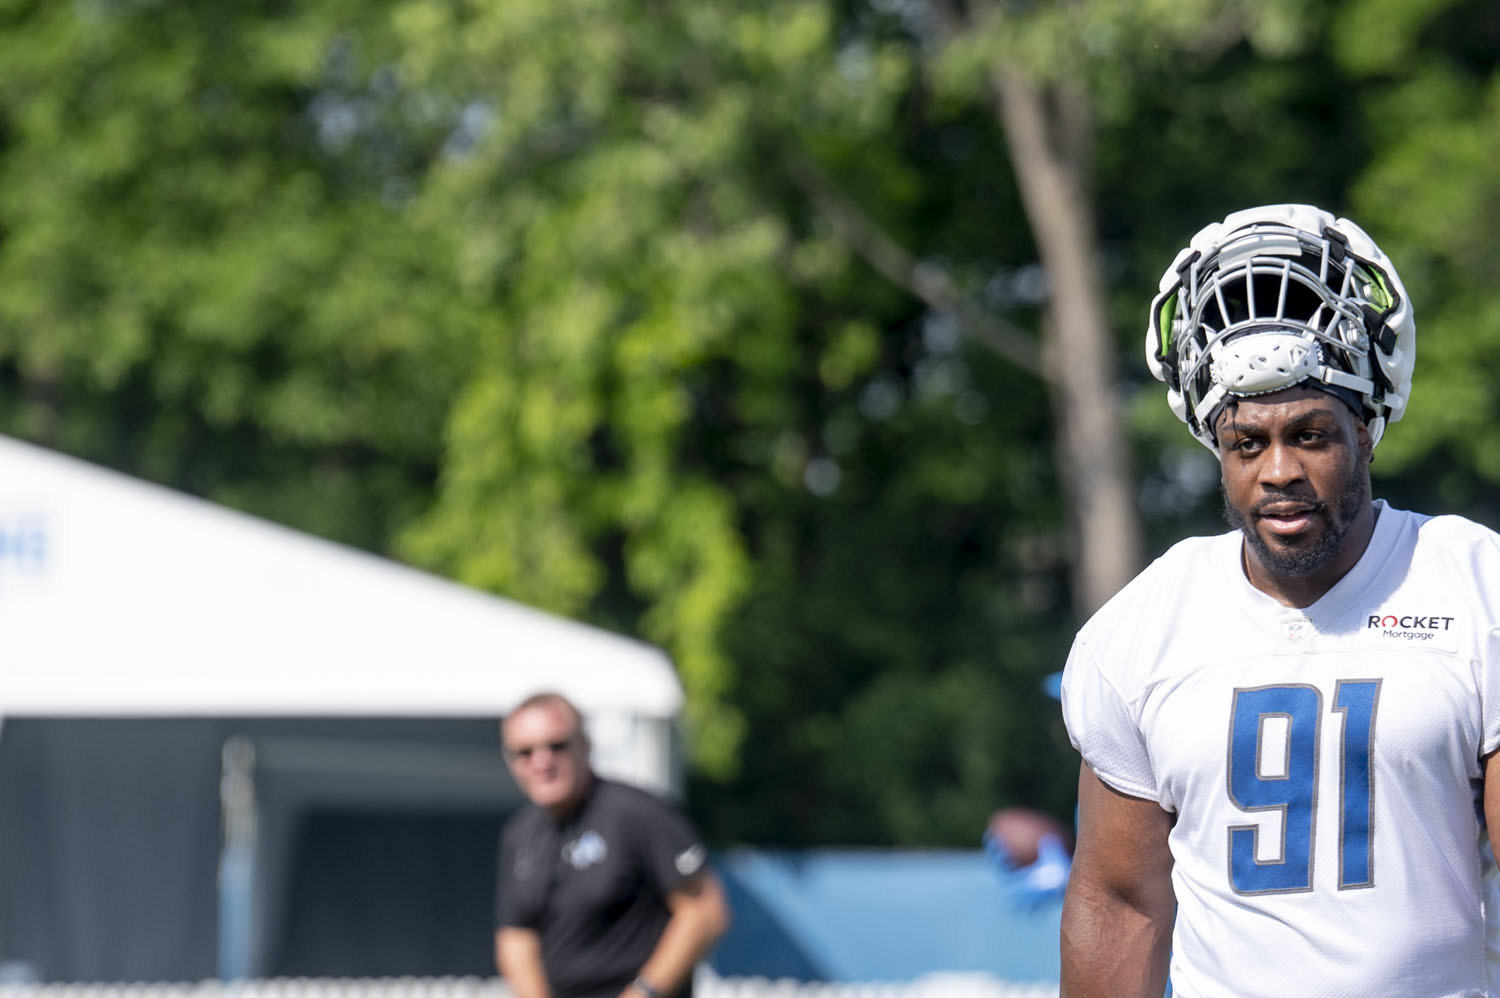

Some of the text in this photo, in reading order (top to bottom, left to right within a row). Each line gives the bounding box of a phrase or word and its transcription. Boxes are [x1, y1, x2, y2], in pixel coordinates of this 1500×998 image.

[1367, 615, 1454, 630] ROCKET
[1383, 630, 1434, 641] Mortgage
[1226, 678, 1383, 896] 91
